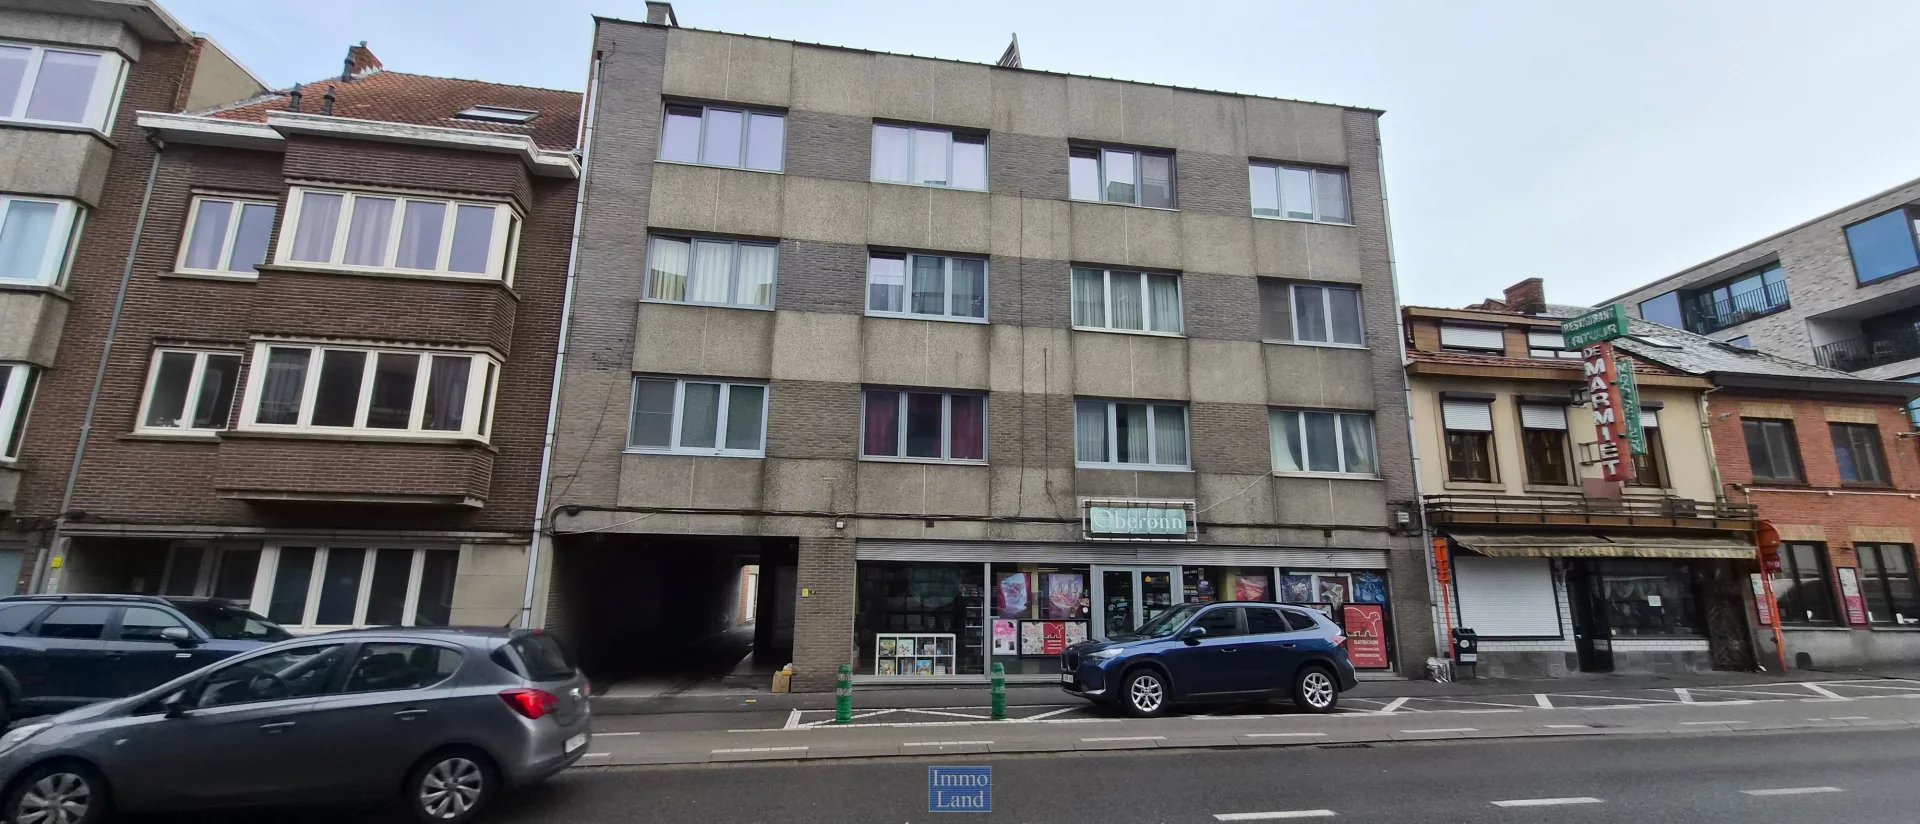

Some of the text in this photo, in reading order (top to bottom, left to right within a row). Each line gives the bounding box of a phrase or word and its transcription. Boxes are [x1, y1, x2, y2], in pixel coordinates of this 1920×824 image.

[1561, 307, 1614, 333] RESTAURANT
[1583, 345, 1601, 359] DE
[1584, 358, 1619, 475] MARMIET
